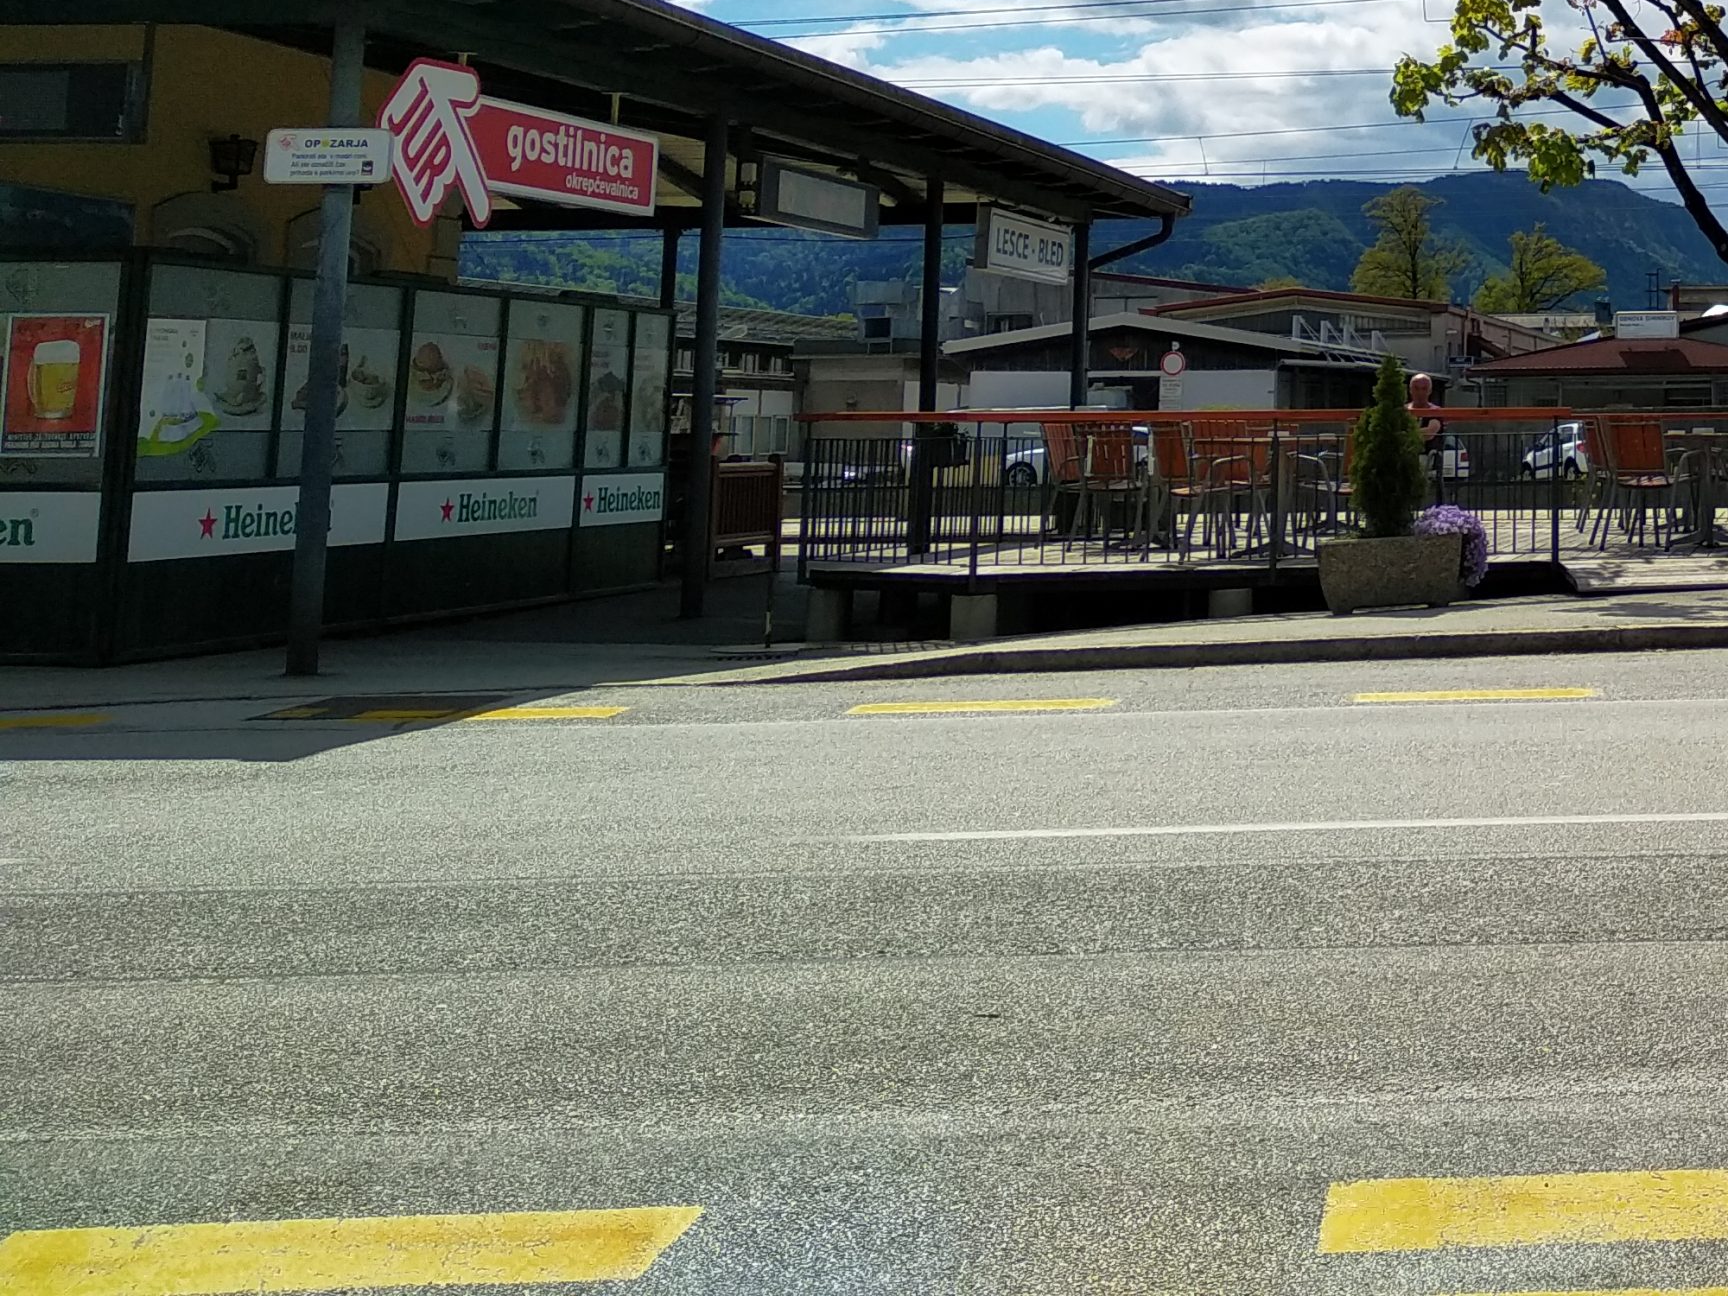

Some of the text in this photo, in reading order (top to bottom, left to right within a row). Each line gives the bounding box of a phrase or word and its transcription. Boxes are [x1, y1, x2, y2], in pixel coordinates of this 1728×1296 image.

[507, 124, 633, 179] gostilnica
[565, 172, 639, 200] okrepčevalnica
[995, 227, 1030, 260] LESCE
[1037, 238, 1064, 267] BLED
[457, 491, 539, 523] Heineken
[597, 485, 661, 514] Heineken
[222, 502, 331, 540] Heine
